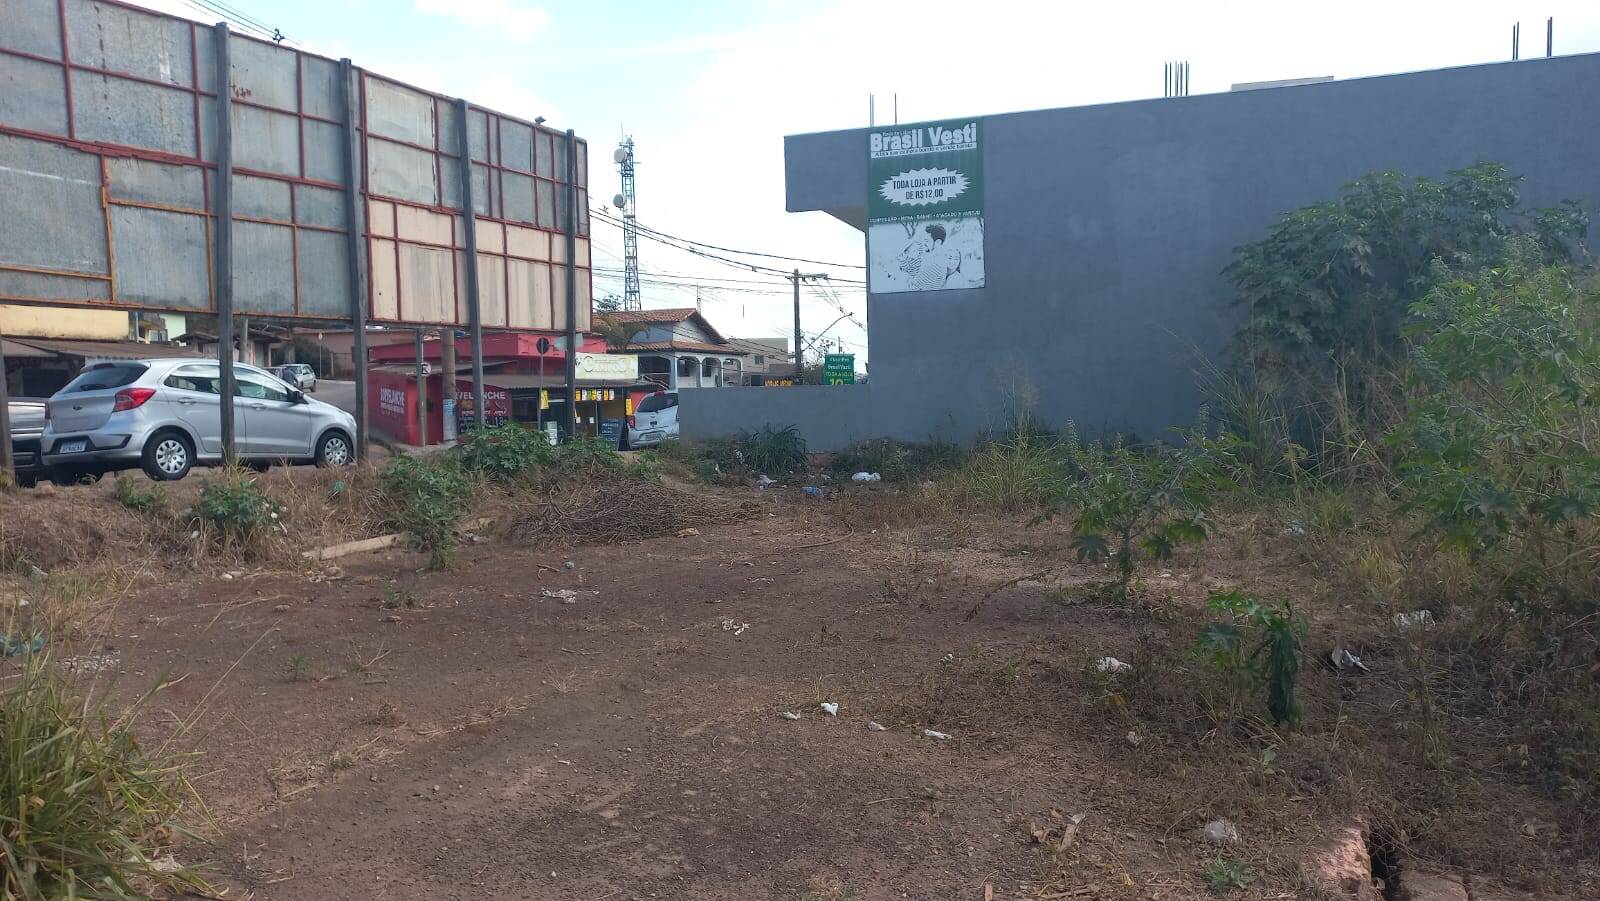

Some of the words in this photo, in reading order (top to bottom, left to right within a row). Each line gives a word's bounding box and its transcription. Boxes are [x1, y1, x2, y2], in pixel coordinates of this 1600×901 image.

[870, 129, 923, 152] Brasil
[928, 122, 977, 147] Vesti
[893, 180, 910, 190] TODA
[911, 178, 926, 188] LOJA
[927, 178, 932, 186] A
[933, 175, 957, 186] PARTIR
[905, 191, 914, 199] DE
[915, 188, 944, 199] R$12,00
